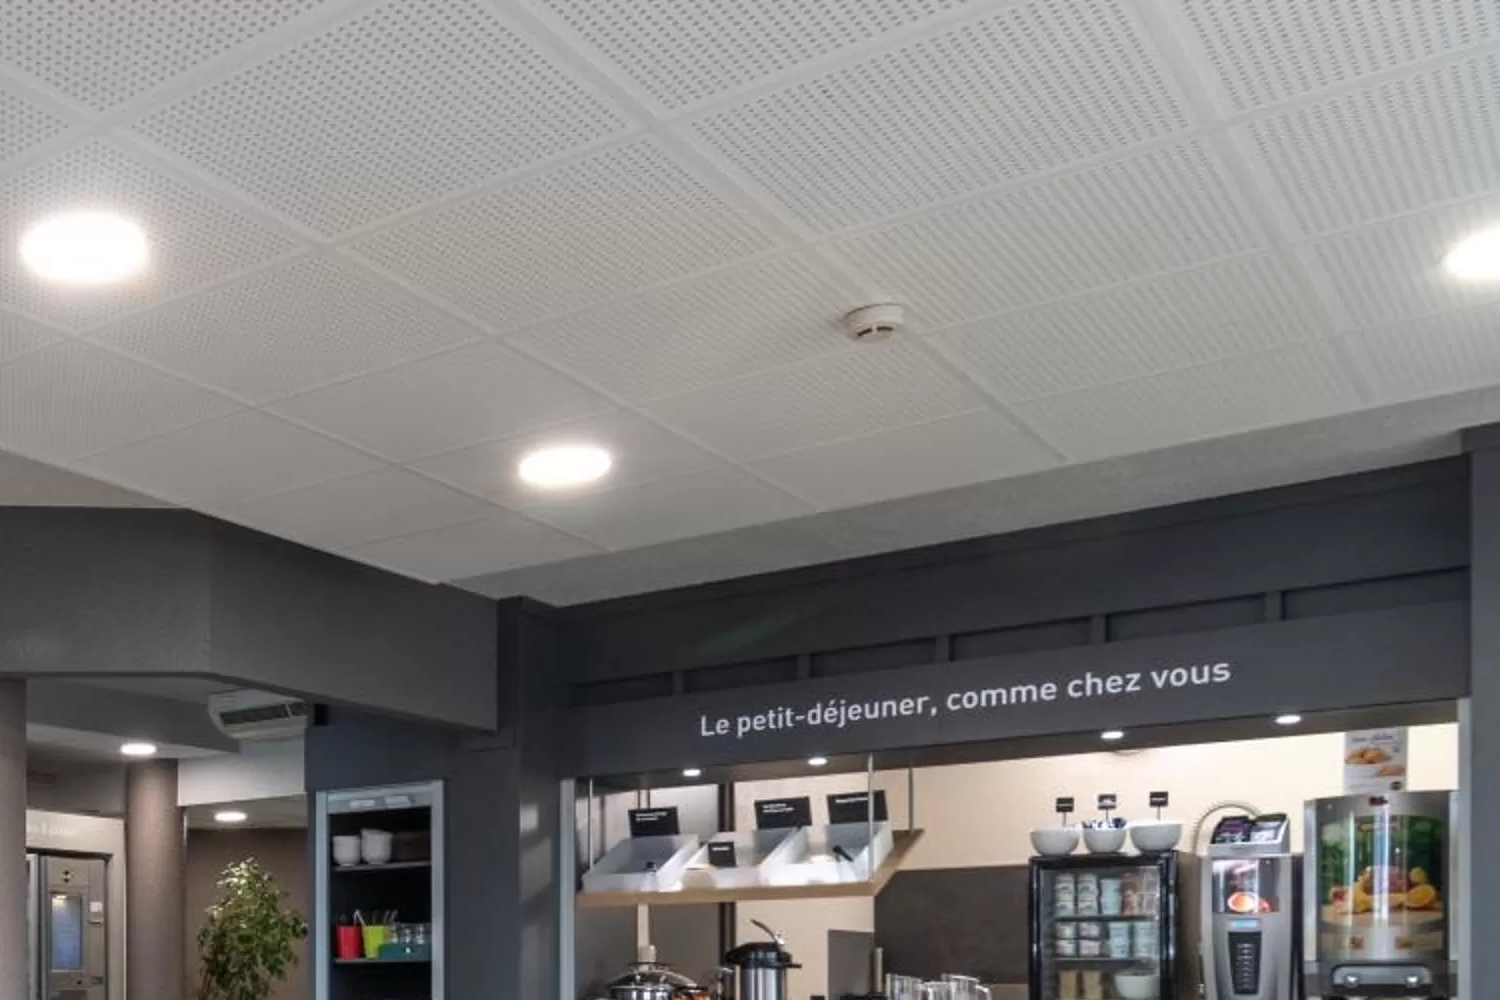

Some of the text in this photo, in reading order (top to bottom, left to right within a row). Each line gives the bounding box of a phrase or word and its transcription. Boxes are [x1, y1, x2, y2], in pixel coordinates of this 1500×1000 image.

[700, 662, 1232, 739] Le petit-déjeuner, comme chez vous
